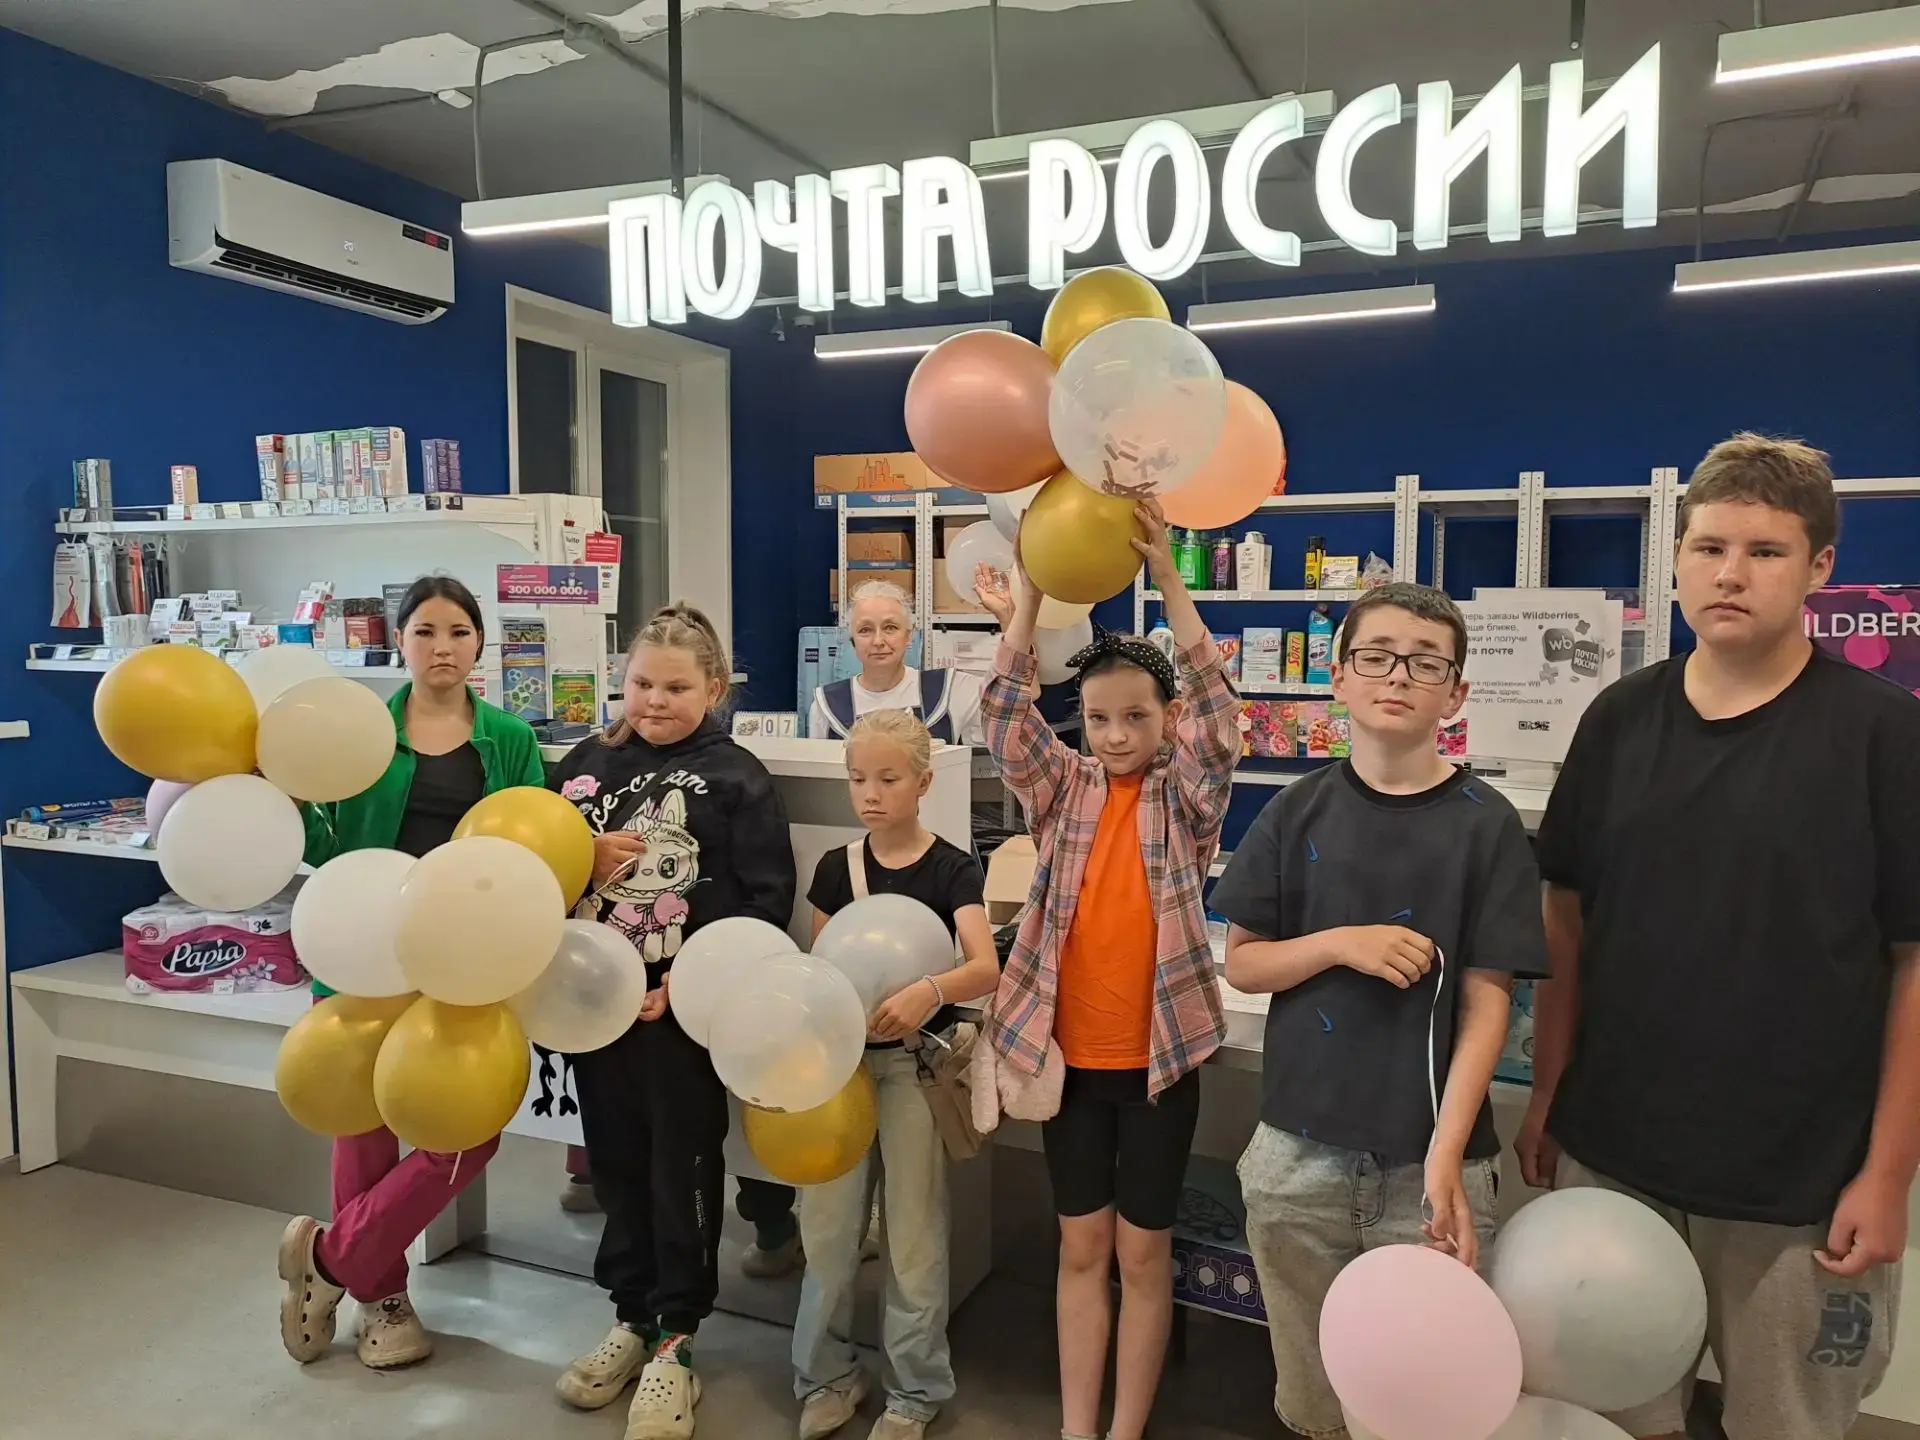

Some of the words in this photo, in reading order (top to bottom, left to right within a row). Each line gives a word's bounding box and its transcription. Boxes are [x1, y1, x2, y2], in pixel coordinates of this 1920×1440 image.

[608, 156, 993, 328] ПОЧТА
[1028, 42, 1661, 290] РОССИИ
[508, 585, 530, 594] 300
[534, 585, 557, 594] 000
[561, 586, 583, 595] 000
[1522, 611, 1580, 620] Wildberries
[1494, 636, 1528, 645] получи
[1481, 647, 1514, 656] почте
[1575, 648, 1600, 661] ПОЧТА
[169, 939, 242, 973] Papia
